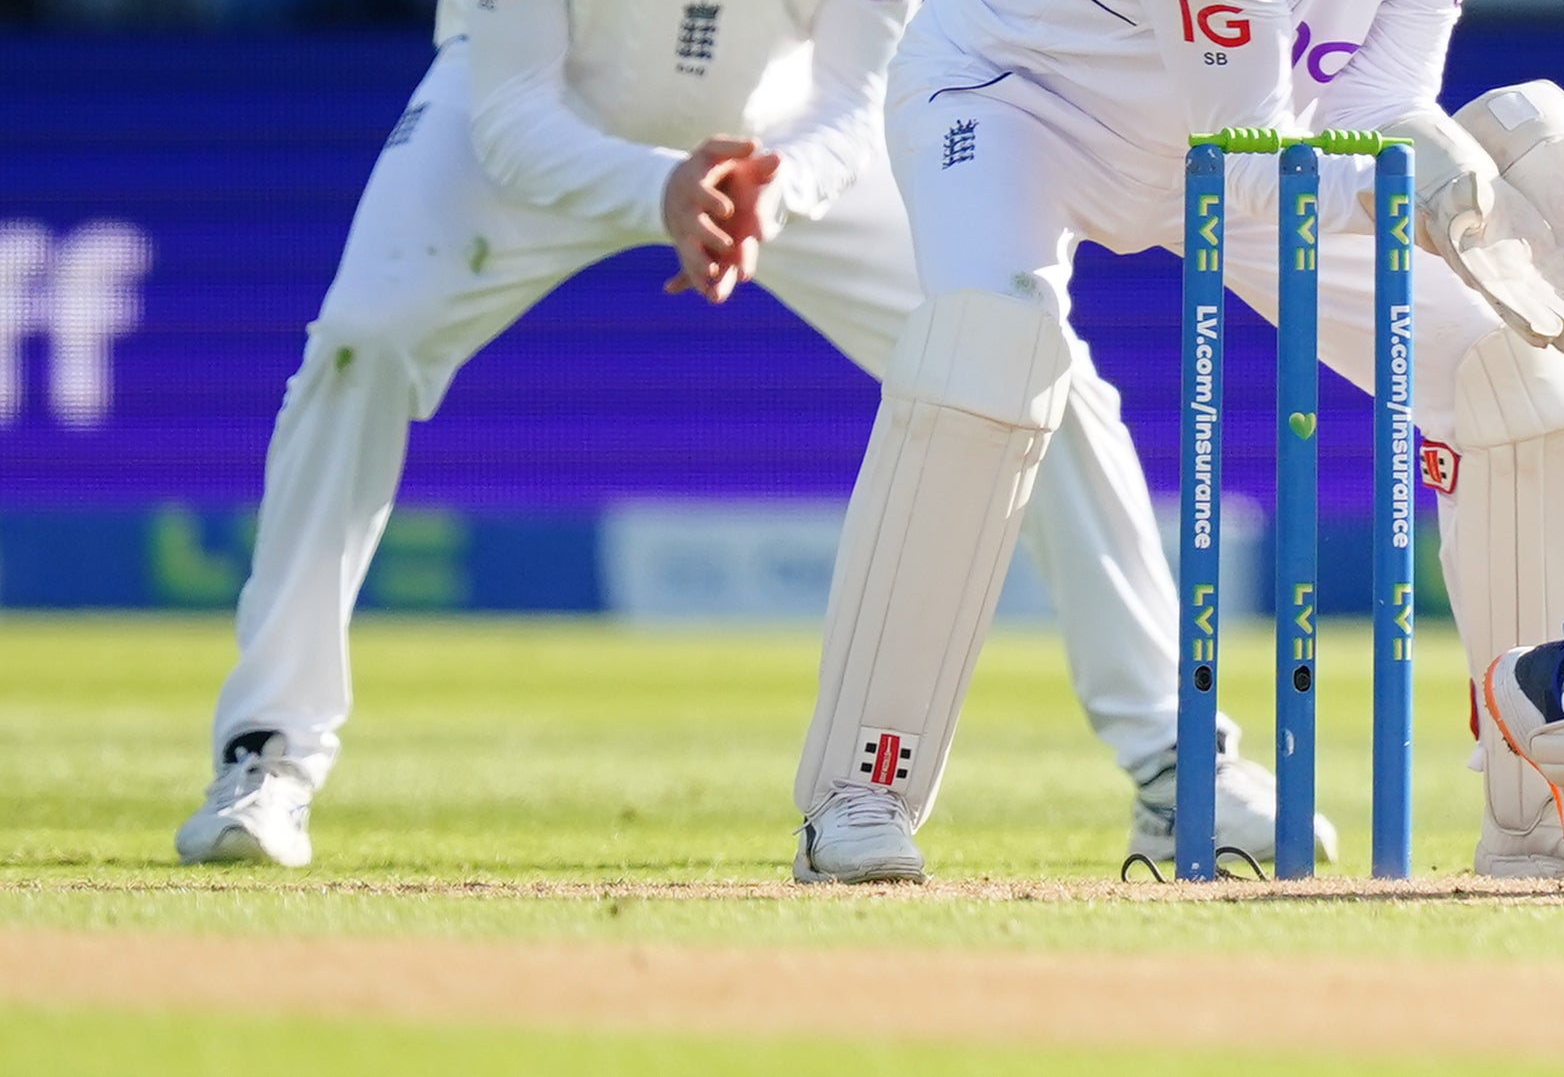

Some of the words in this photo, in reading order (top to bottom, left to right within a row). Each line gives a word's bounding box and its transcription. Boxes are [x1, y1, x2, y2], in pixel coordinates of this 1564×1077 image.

[1203, 52, 1228, 66] SB
[1190, 304, 1218, 550] LV.com/insurance
[1386, 304, 1413, 549] LV.com/insurance
